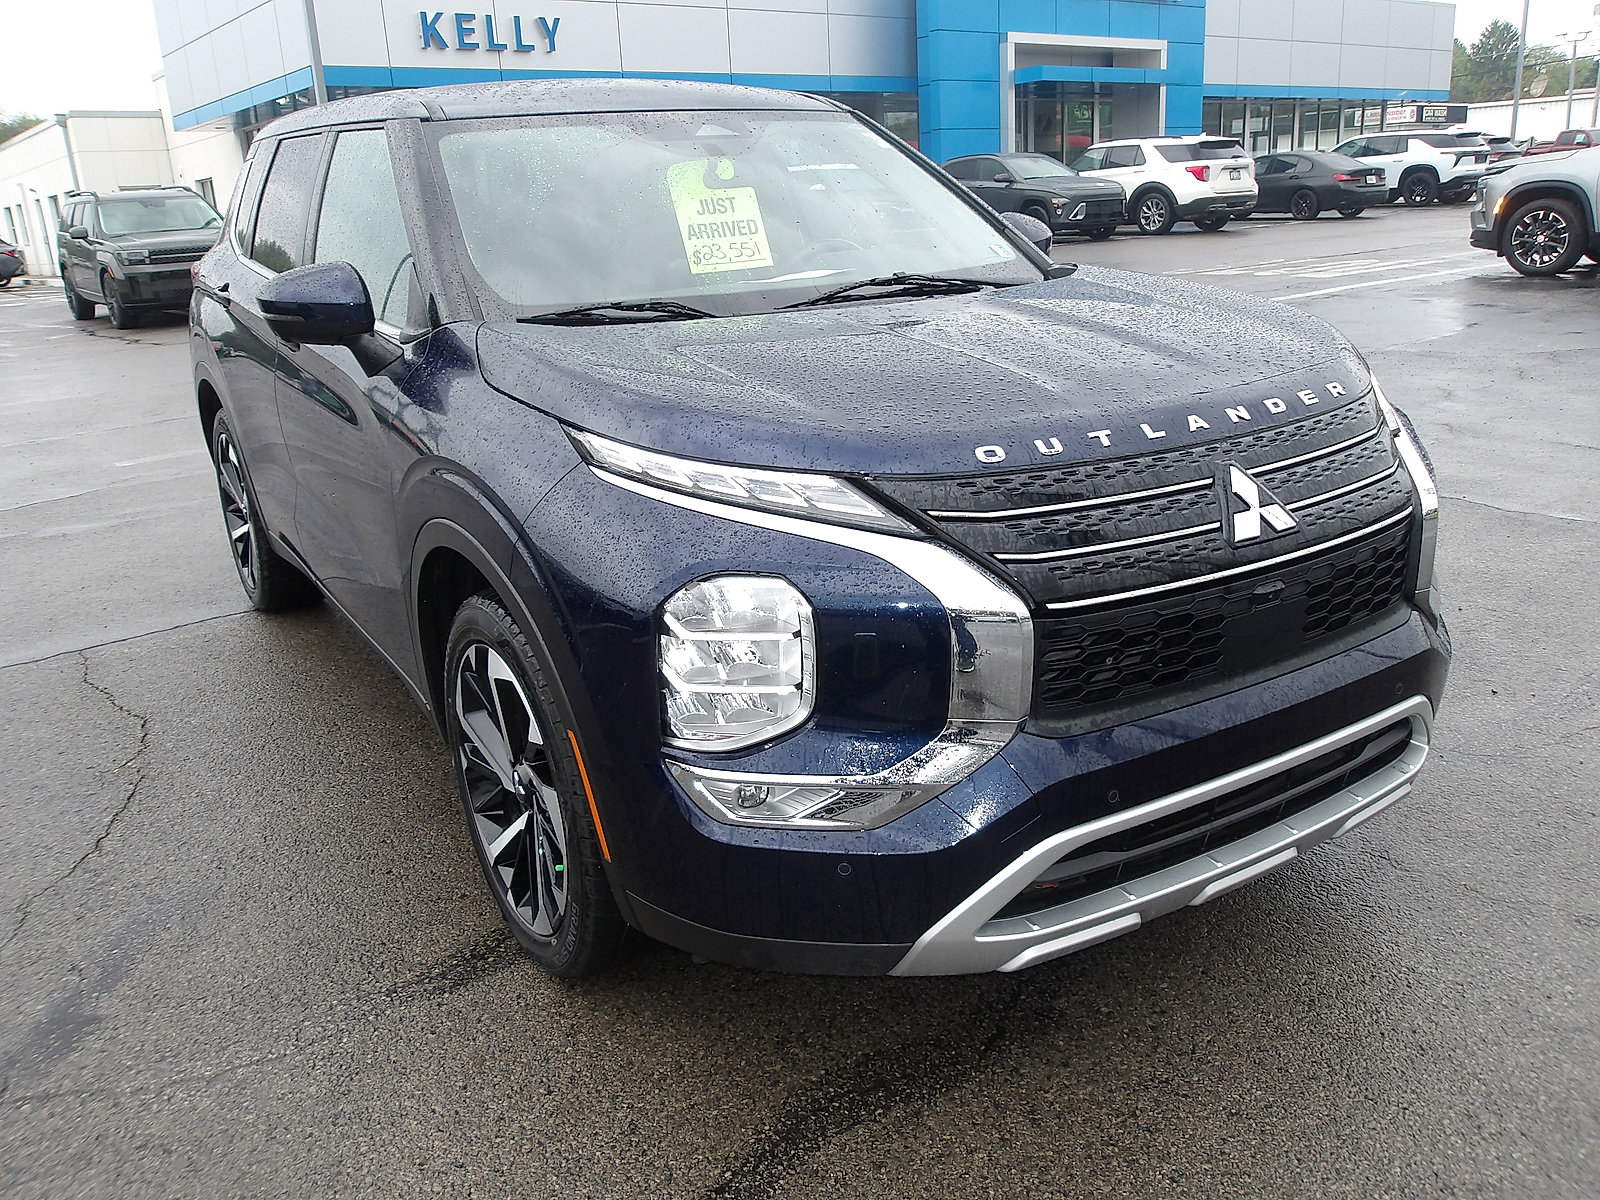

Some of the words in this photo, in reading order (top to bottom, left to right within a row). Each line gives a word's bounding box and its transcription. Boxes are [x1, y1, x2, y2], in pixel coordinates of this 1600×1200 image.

[419, 11, 560, 52] KELLY
[696, 197, 736, 215] JUST
[687, 219, 758, 240] ARRIVED
[693, 241, 761, 266] $23,551
[974, 381, 1347, 463] OUTLANDER
[566, 902, 579, 952] GRAND
